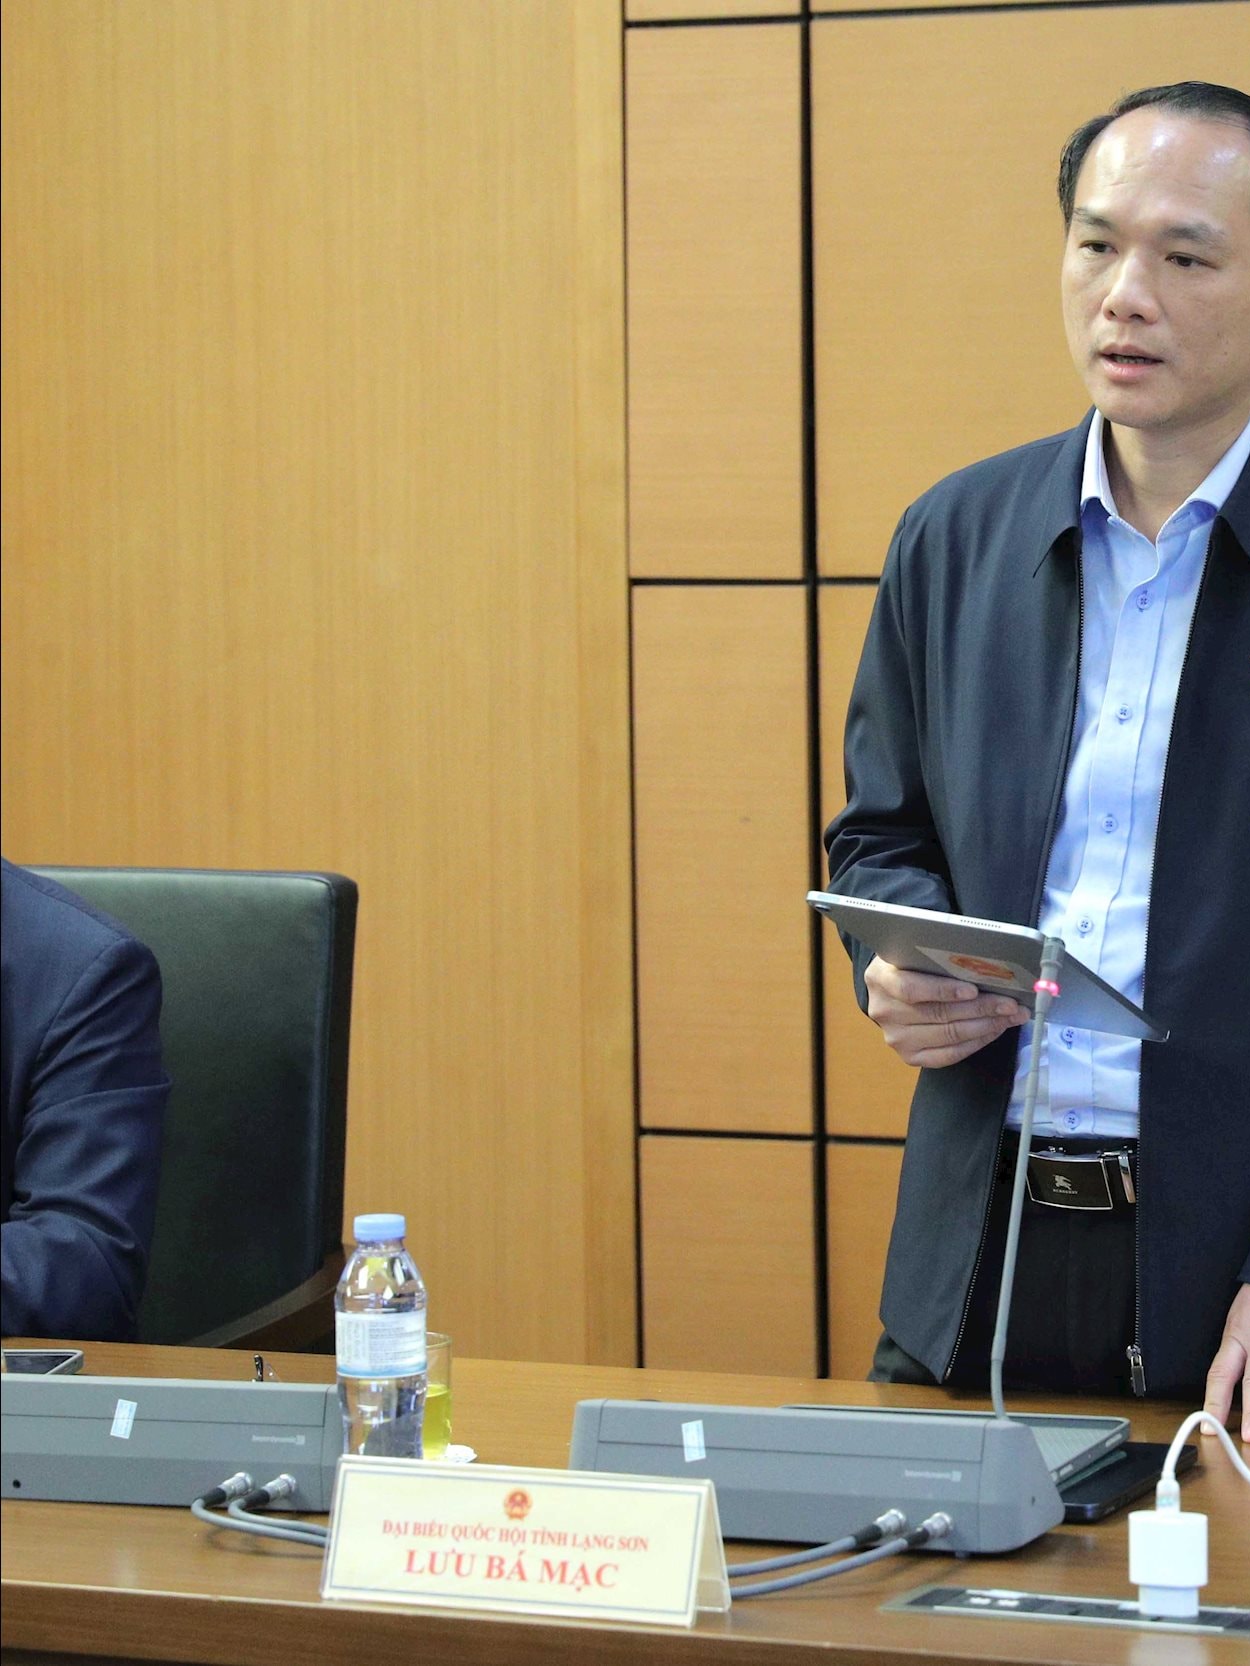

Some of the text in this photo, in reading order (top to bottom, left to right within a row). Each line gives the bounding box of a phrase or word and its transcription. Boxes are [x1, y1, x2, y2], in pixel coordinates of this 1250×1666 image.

[499, 1526, 526, 1546] HỘI
[404, 1548, 619, 1592] LƯU BÁ MẠC
